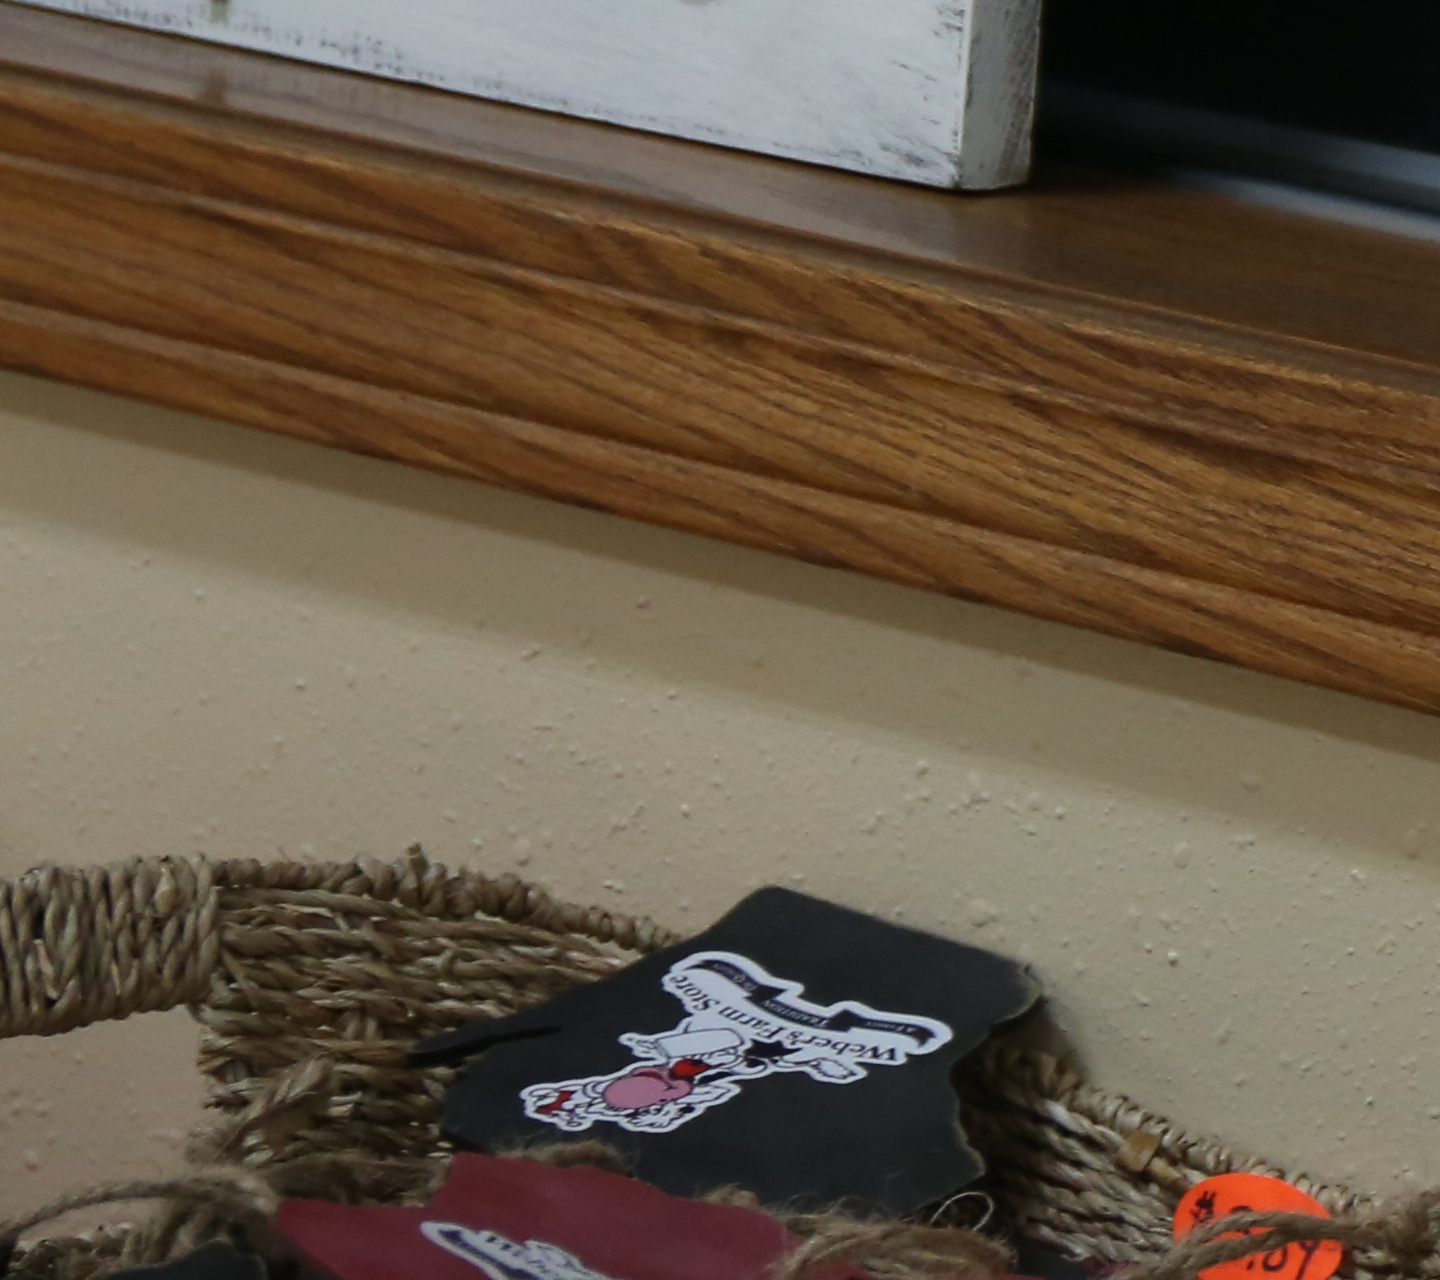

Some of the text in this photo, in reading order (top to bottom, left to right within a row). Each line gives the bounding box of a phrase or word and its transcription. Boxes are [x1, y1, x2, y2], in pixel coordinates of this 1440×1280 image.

[669, 974, 897, 1061] Weber's Farm Store
